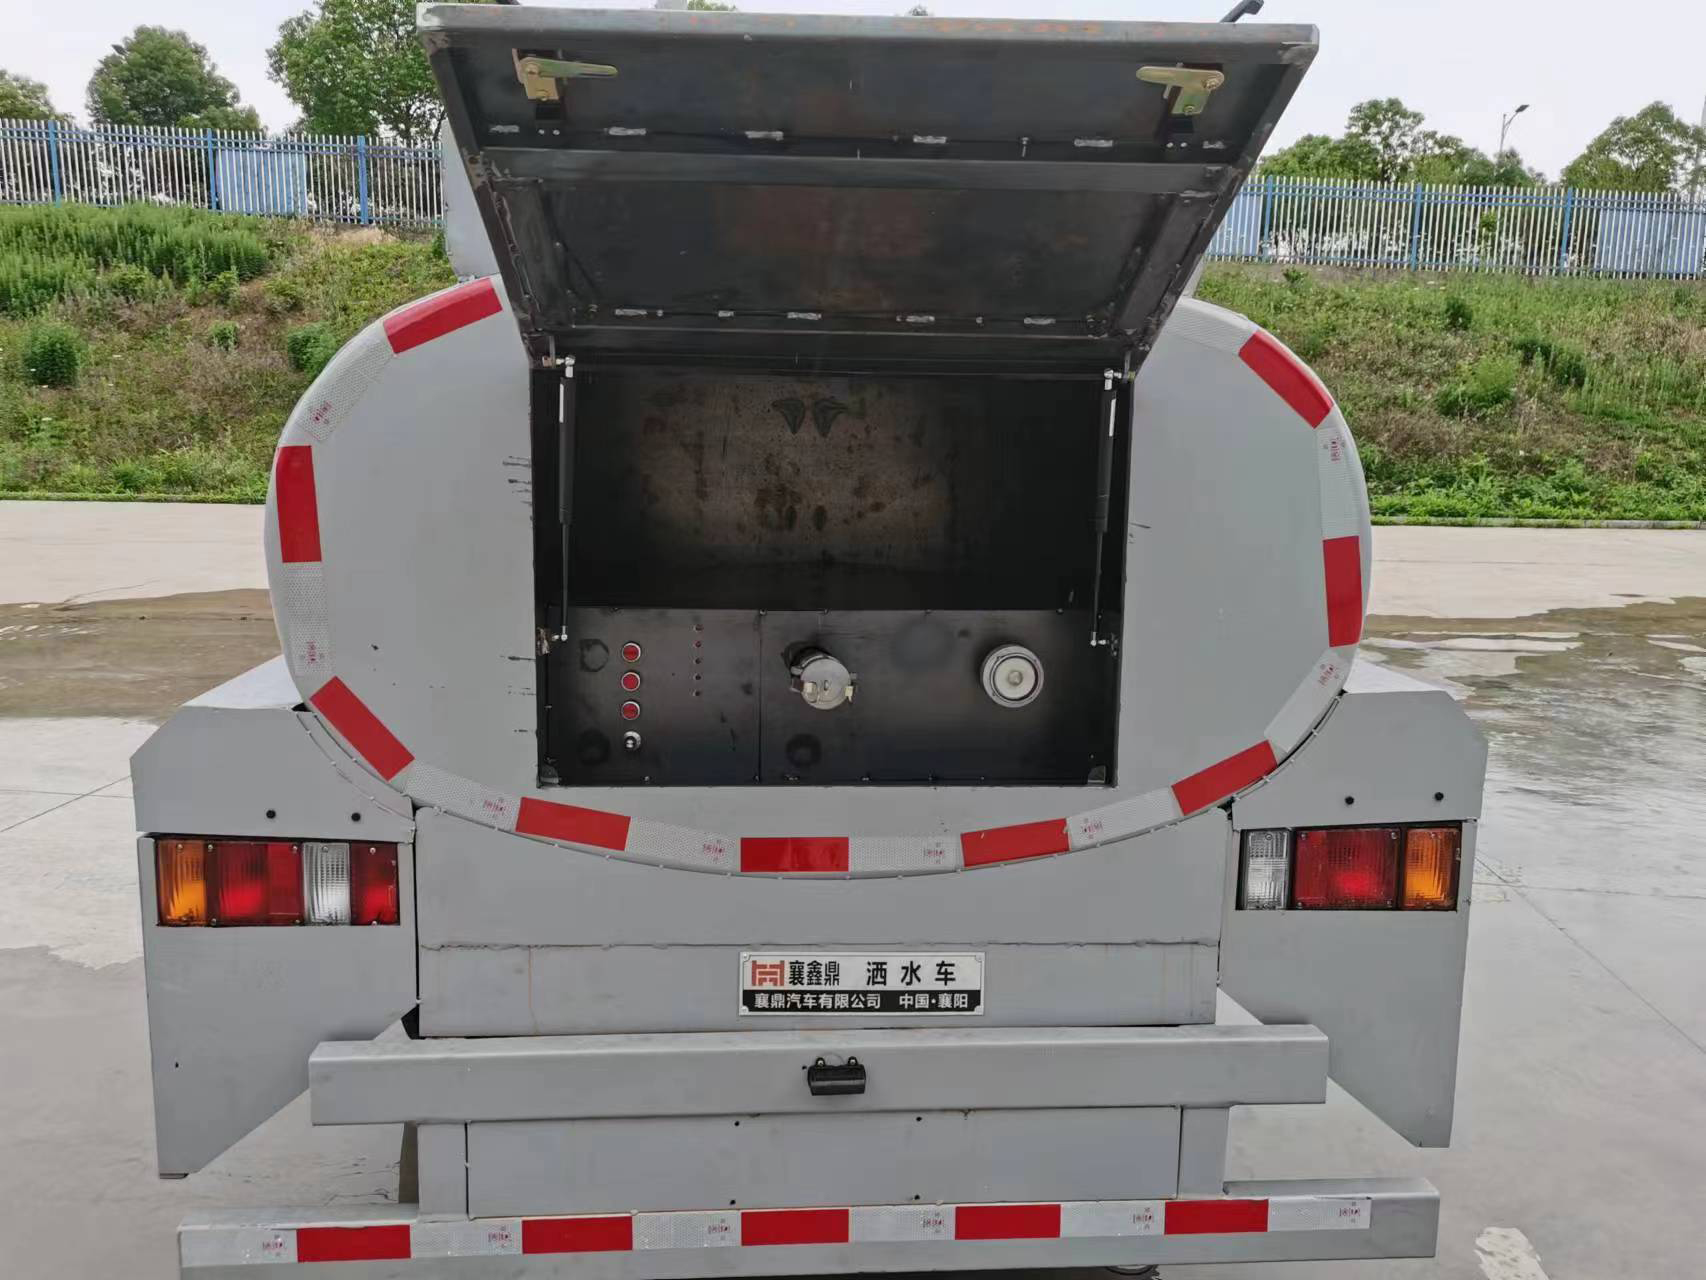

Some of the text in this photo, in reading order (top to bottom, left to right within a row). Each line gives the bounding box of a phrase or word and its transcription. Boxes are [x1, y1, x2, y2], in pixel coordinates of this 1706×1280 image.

[788, 960, 841, 986] 襄鑫鼎
[754, 993, 881, 1009] 襄鼎汽车有限公司
